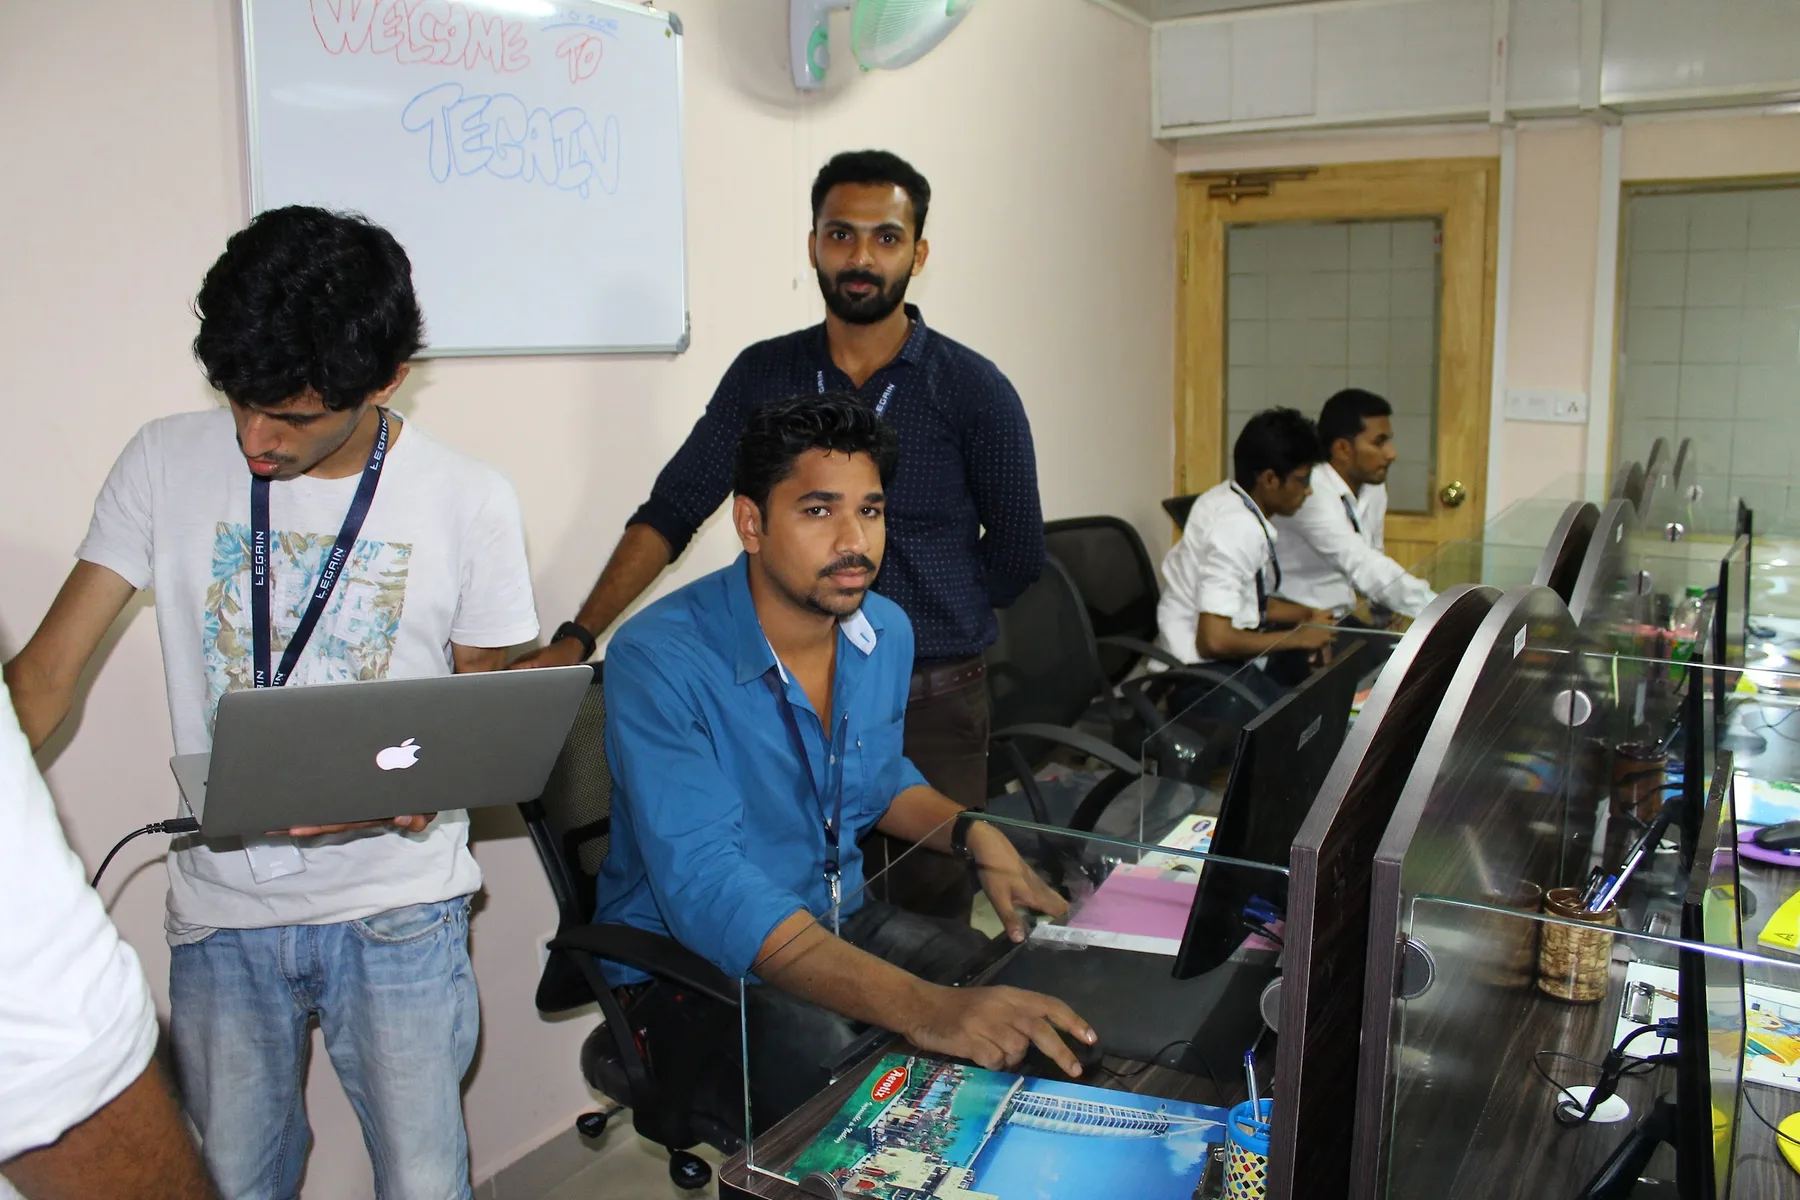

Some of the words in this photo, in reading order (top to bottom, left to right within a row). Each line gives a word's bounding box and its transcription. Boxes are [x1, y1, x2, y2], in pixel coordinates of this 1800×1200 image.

[309, 0, 532, 74] WELCOME
[555, 33, 604, 85] TO
[401, 82, 620, 199] TEGAIN
[874, 1069, 905, 1098] Aerotix
